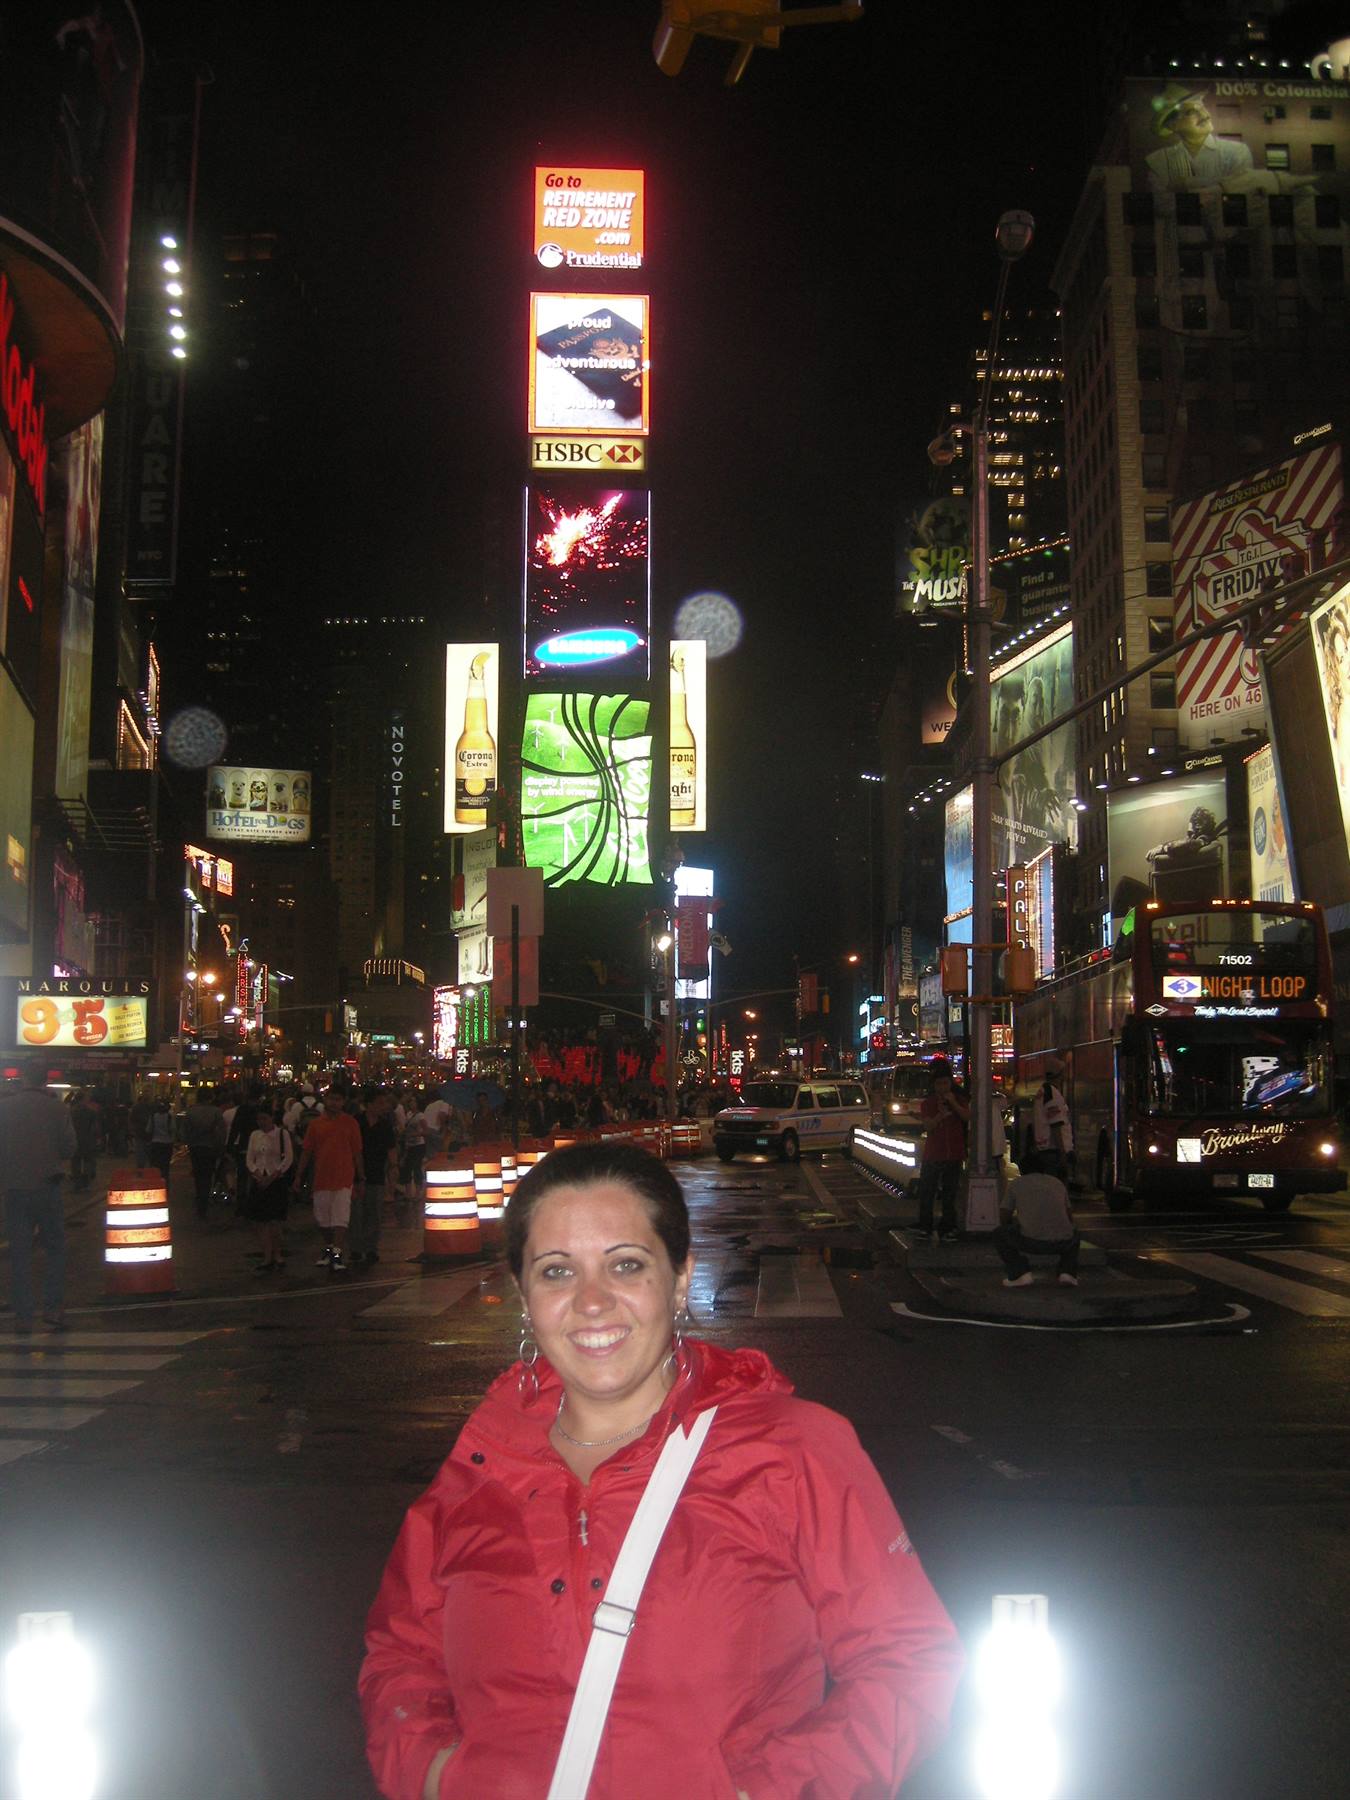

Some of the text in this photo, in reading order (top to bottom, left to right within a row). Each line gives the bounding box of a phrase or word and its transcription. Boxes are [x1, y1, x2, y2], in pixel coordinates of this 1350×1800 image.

[1215, 82, 1257, 96] 100%
[545, 174, 582, 188] Go to
[543, 190, 636, 209] RETIREMENT
[543, 207, 632, 229] RED ZONE
[595, 231, 631, 245] .com
[566, 250, 642, 267] Prudential
[567, 315, 612, 330] proud
[546, 354, 636, 370] dventurous
[533, 442, 603, 463] HSBC
[1021, 571, 1045, 587] Find
[1190, 688, 1263, 721] HERE ON 46
[466, 760, 488, 768] Extra
[391, 726, 404, 827] NOVOTEL
[527, 788, 540, 797] by
[1218, 955, 1253, 965] 71502
[18, 981, 150, 993] MARQUIS
[1177, 976, 1306, 997] 3 NIGHT LOOP
[21, 997, 60, 1045] 9
[72, 998, 108, 1046] 5
[457, 1049, 469, 1074] tkts
[731, 1049, 744, 1075] tkts
[1200, 1122, 1285, 1156] Broadway
